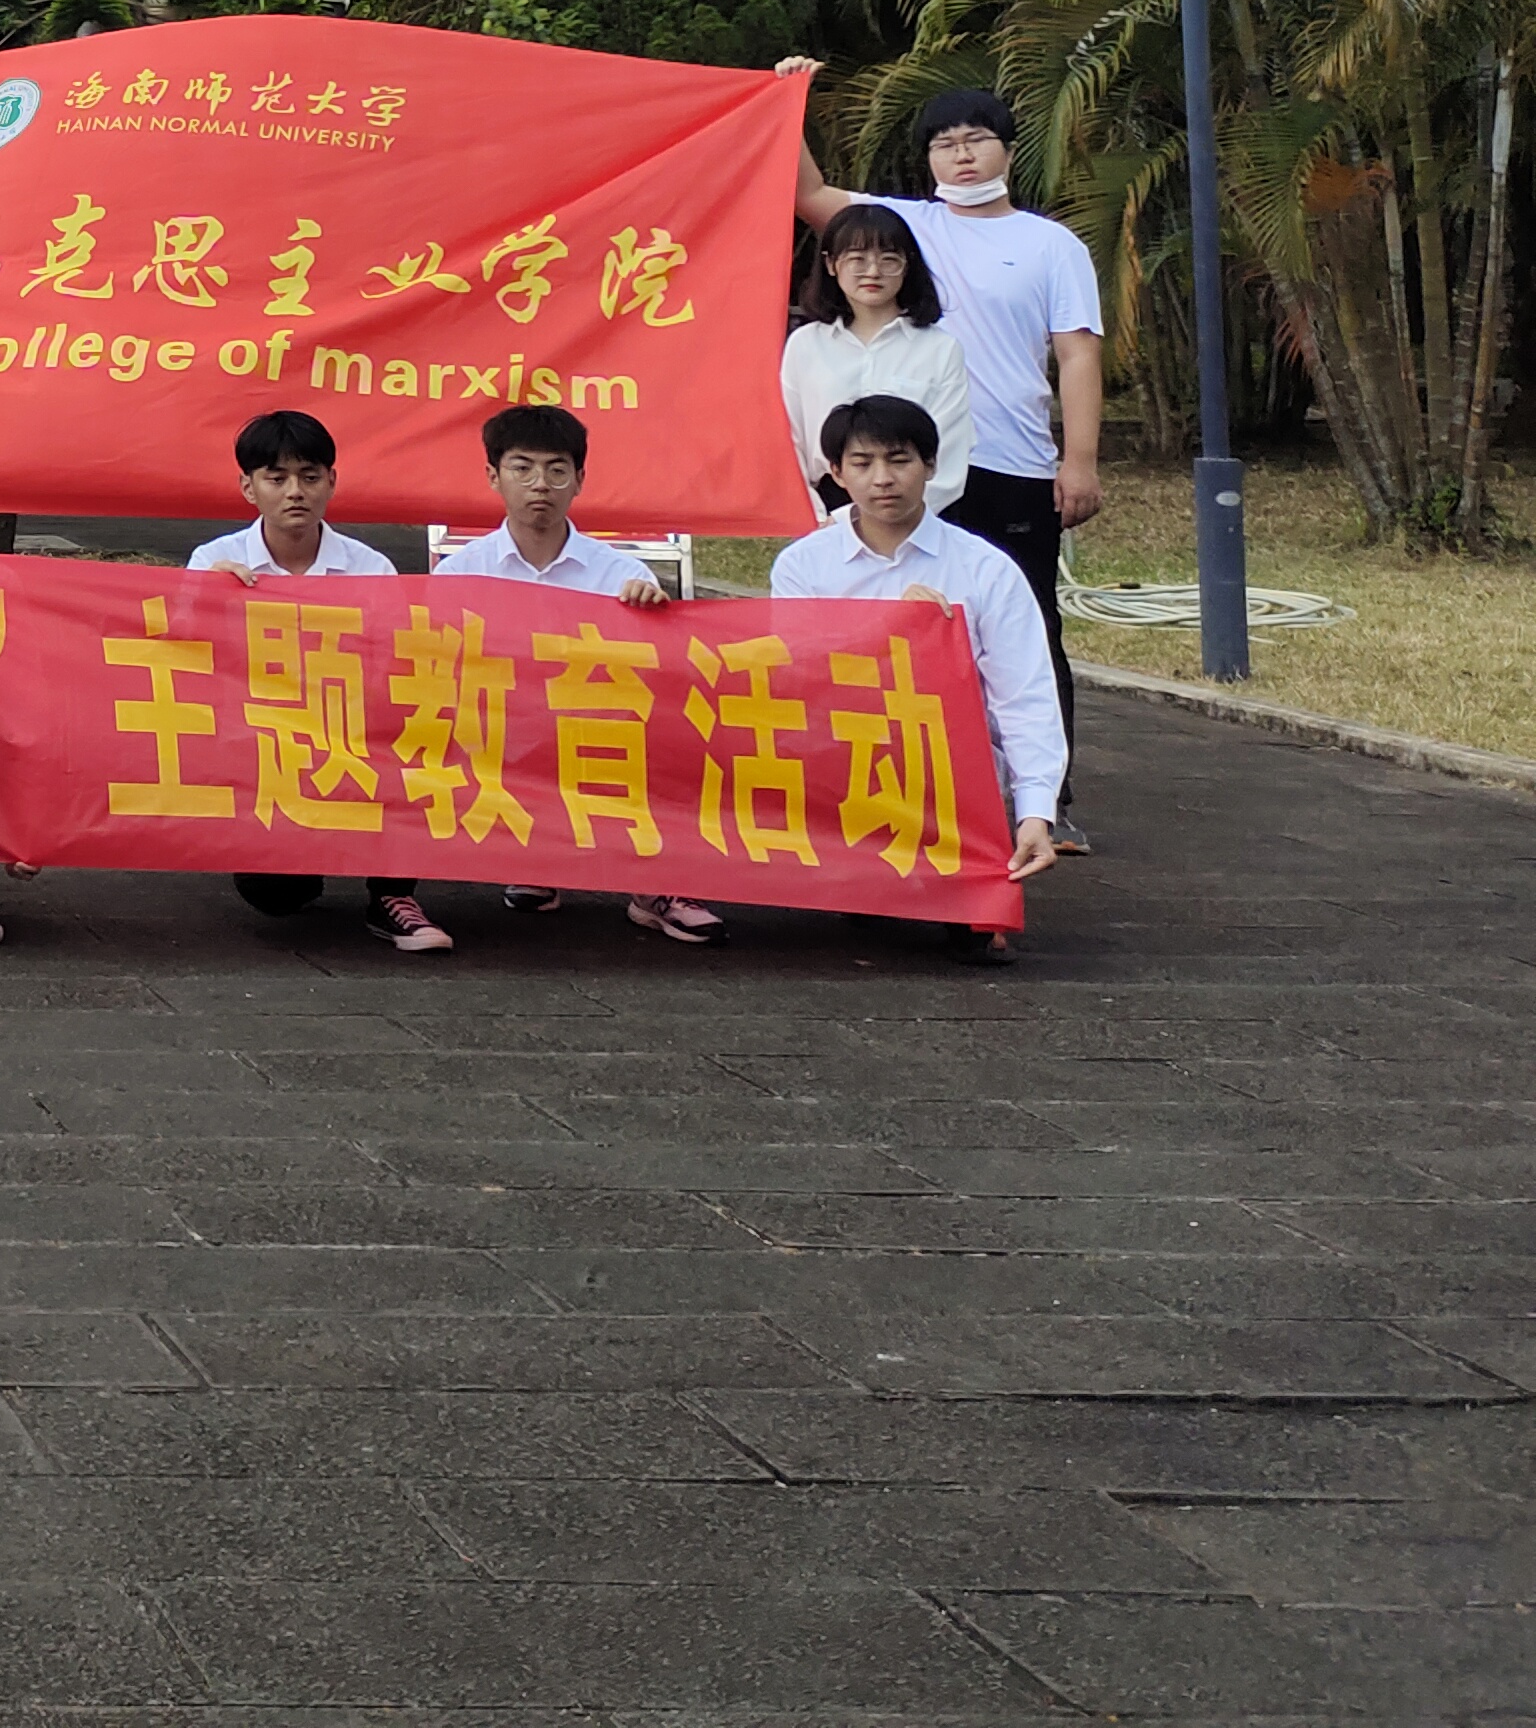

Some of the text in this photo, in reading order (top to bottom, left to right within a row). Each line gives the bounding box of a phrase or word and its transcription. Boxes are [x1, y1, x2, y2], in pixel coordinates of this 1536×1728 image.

[63, 68, 407, 127] 海南师范大学
[56, 115, 396, 153] HAINAN NORMAL UNIVERSITY
[218, 328, 293, 382] of
[310, 346, 639, 410] marxism
[102, 595, 962, 878] 主题教育活动
